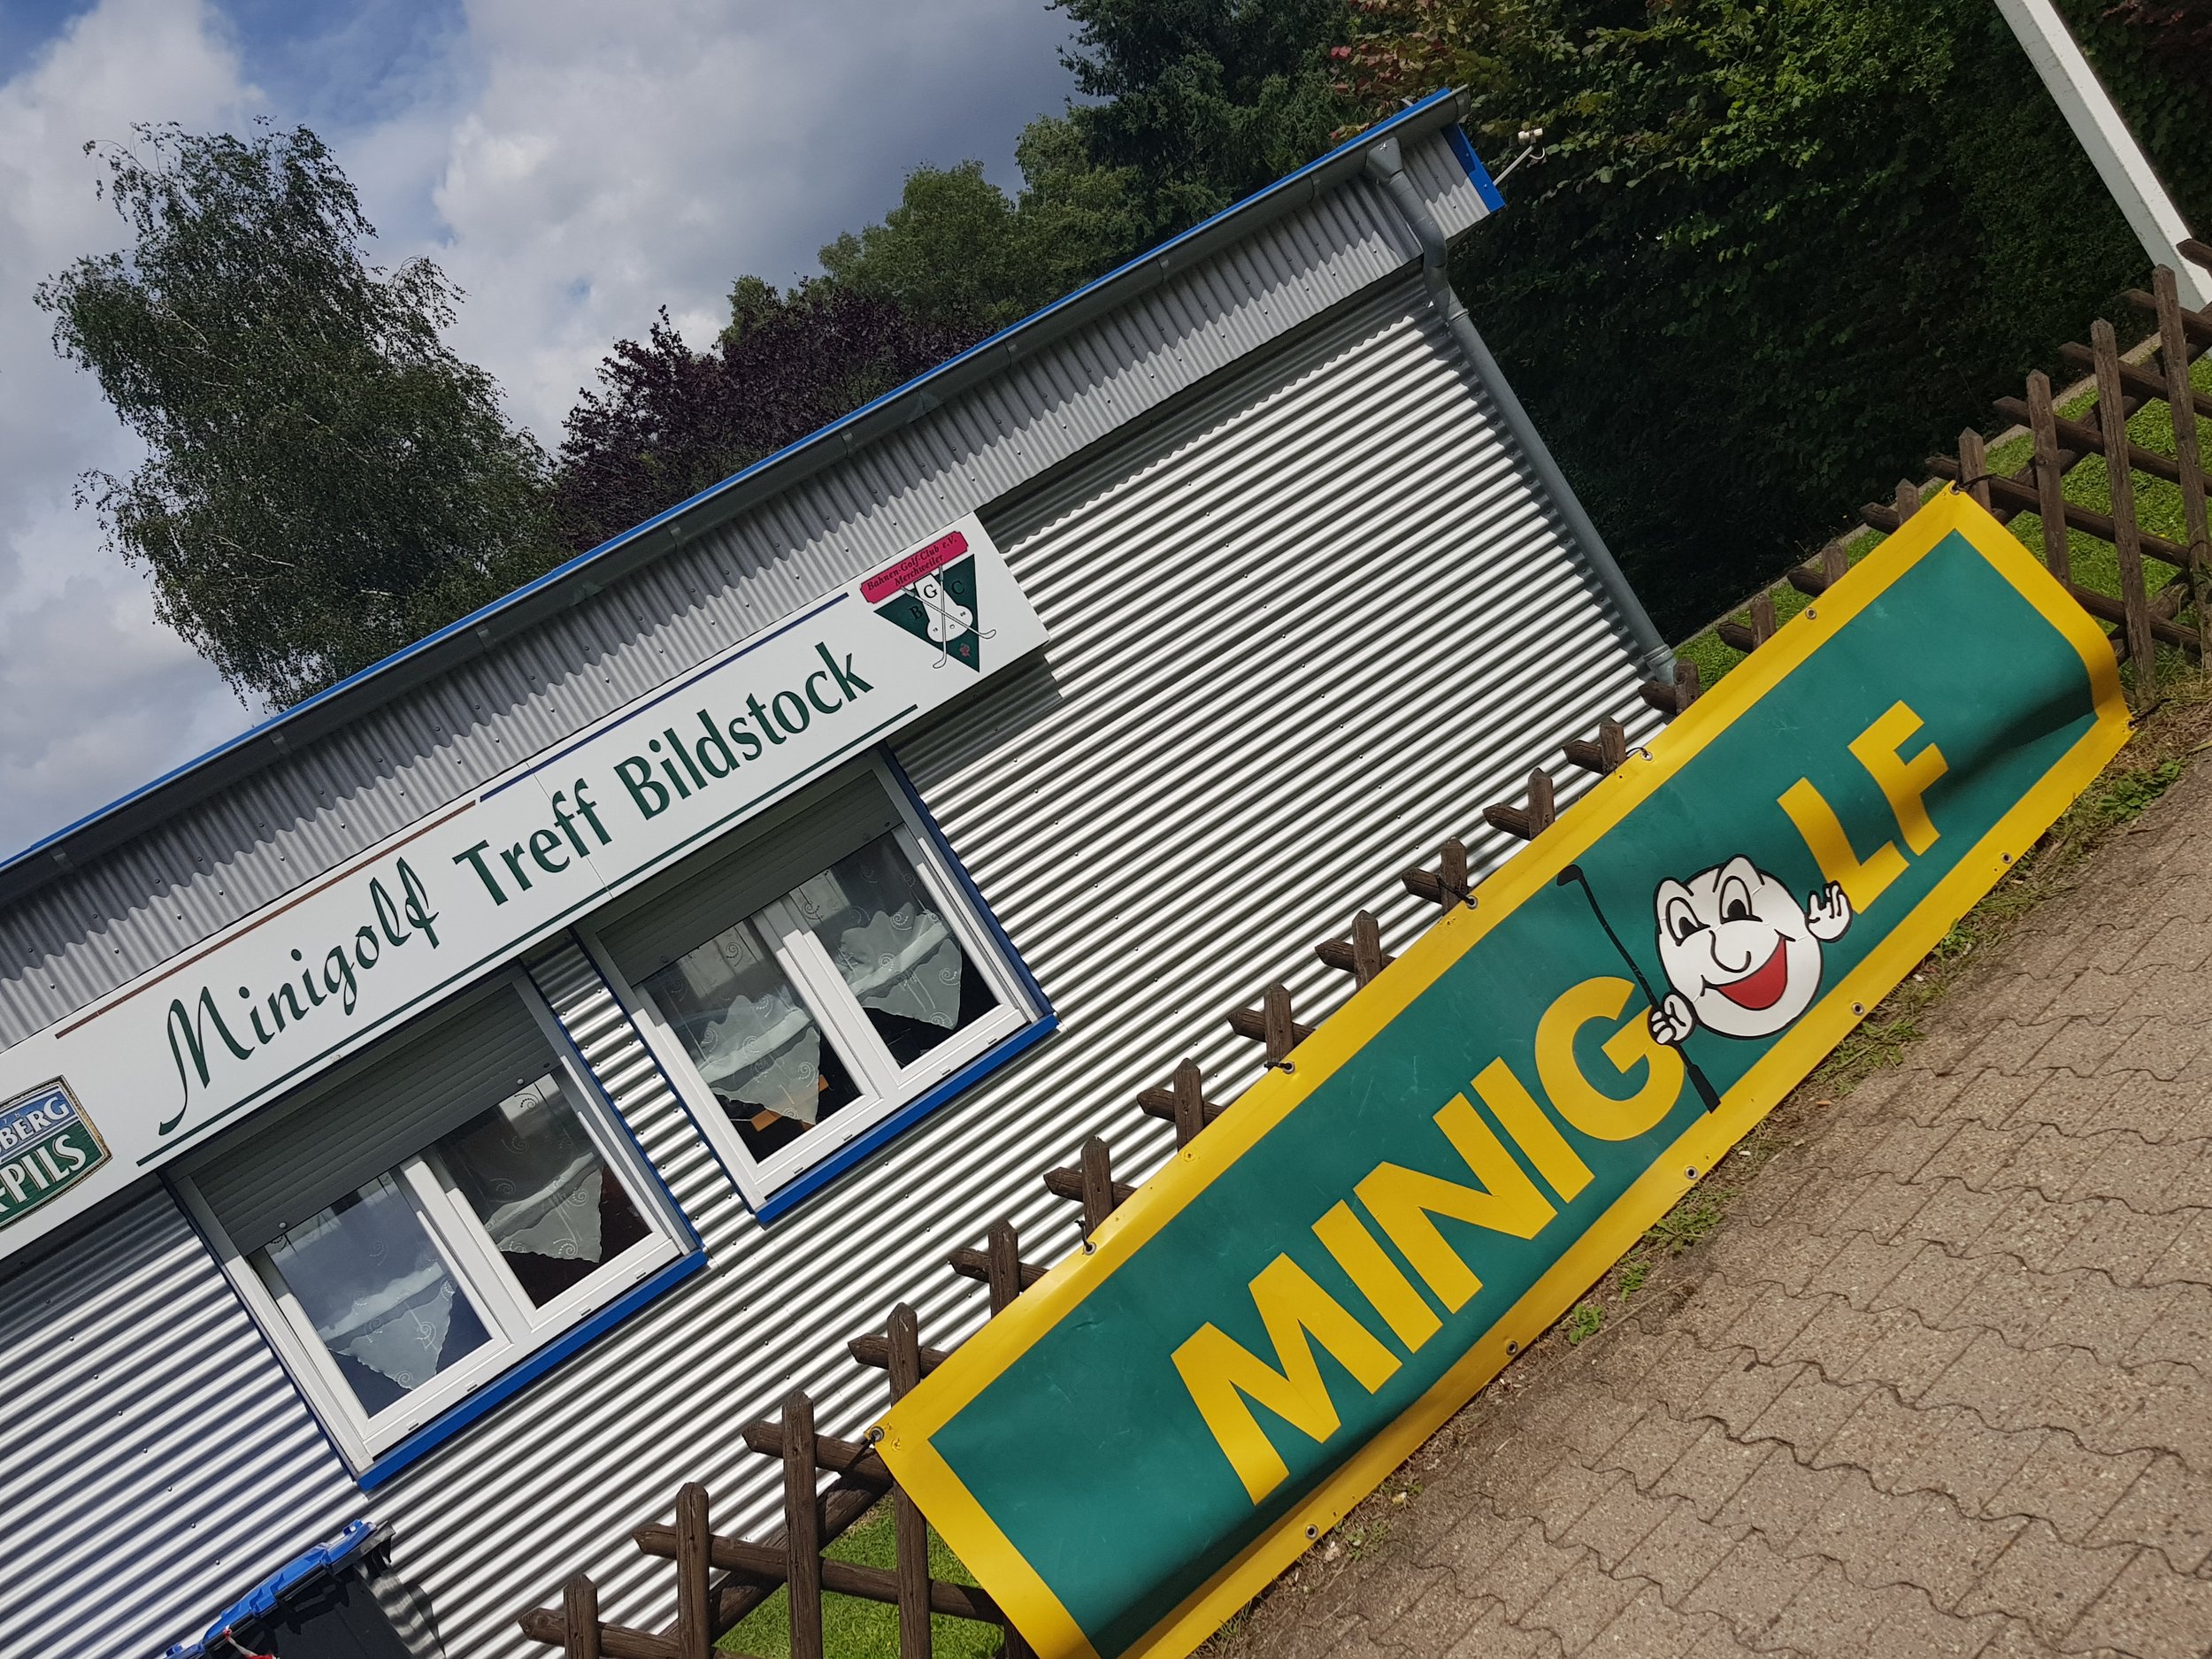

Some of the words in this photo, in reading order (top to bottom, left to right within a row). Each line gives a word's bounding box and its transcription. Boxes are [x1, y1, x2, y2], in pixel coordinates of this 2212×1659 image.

[158, 856, 440, 1137] Minigolf
[452, 779, 613, 906] Treff
[613, 641, 875, 821] Bildstock
